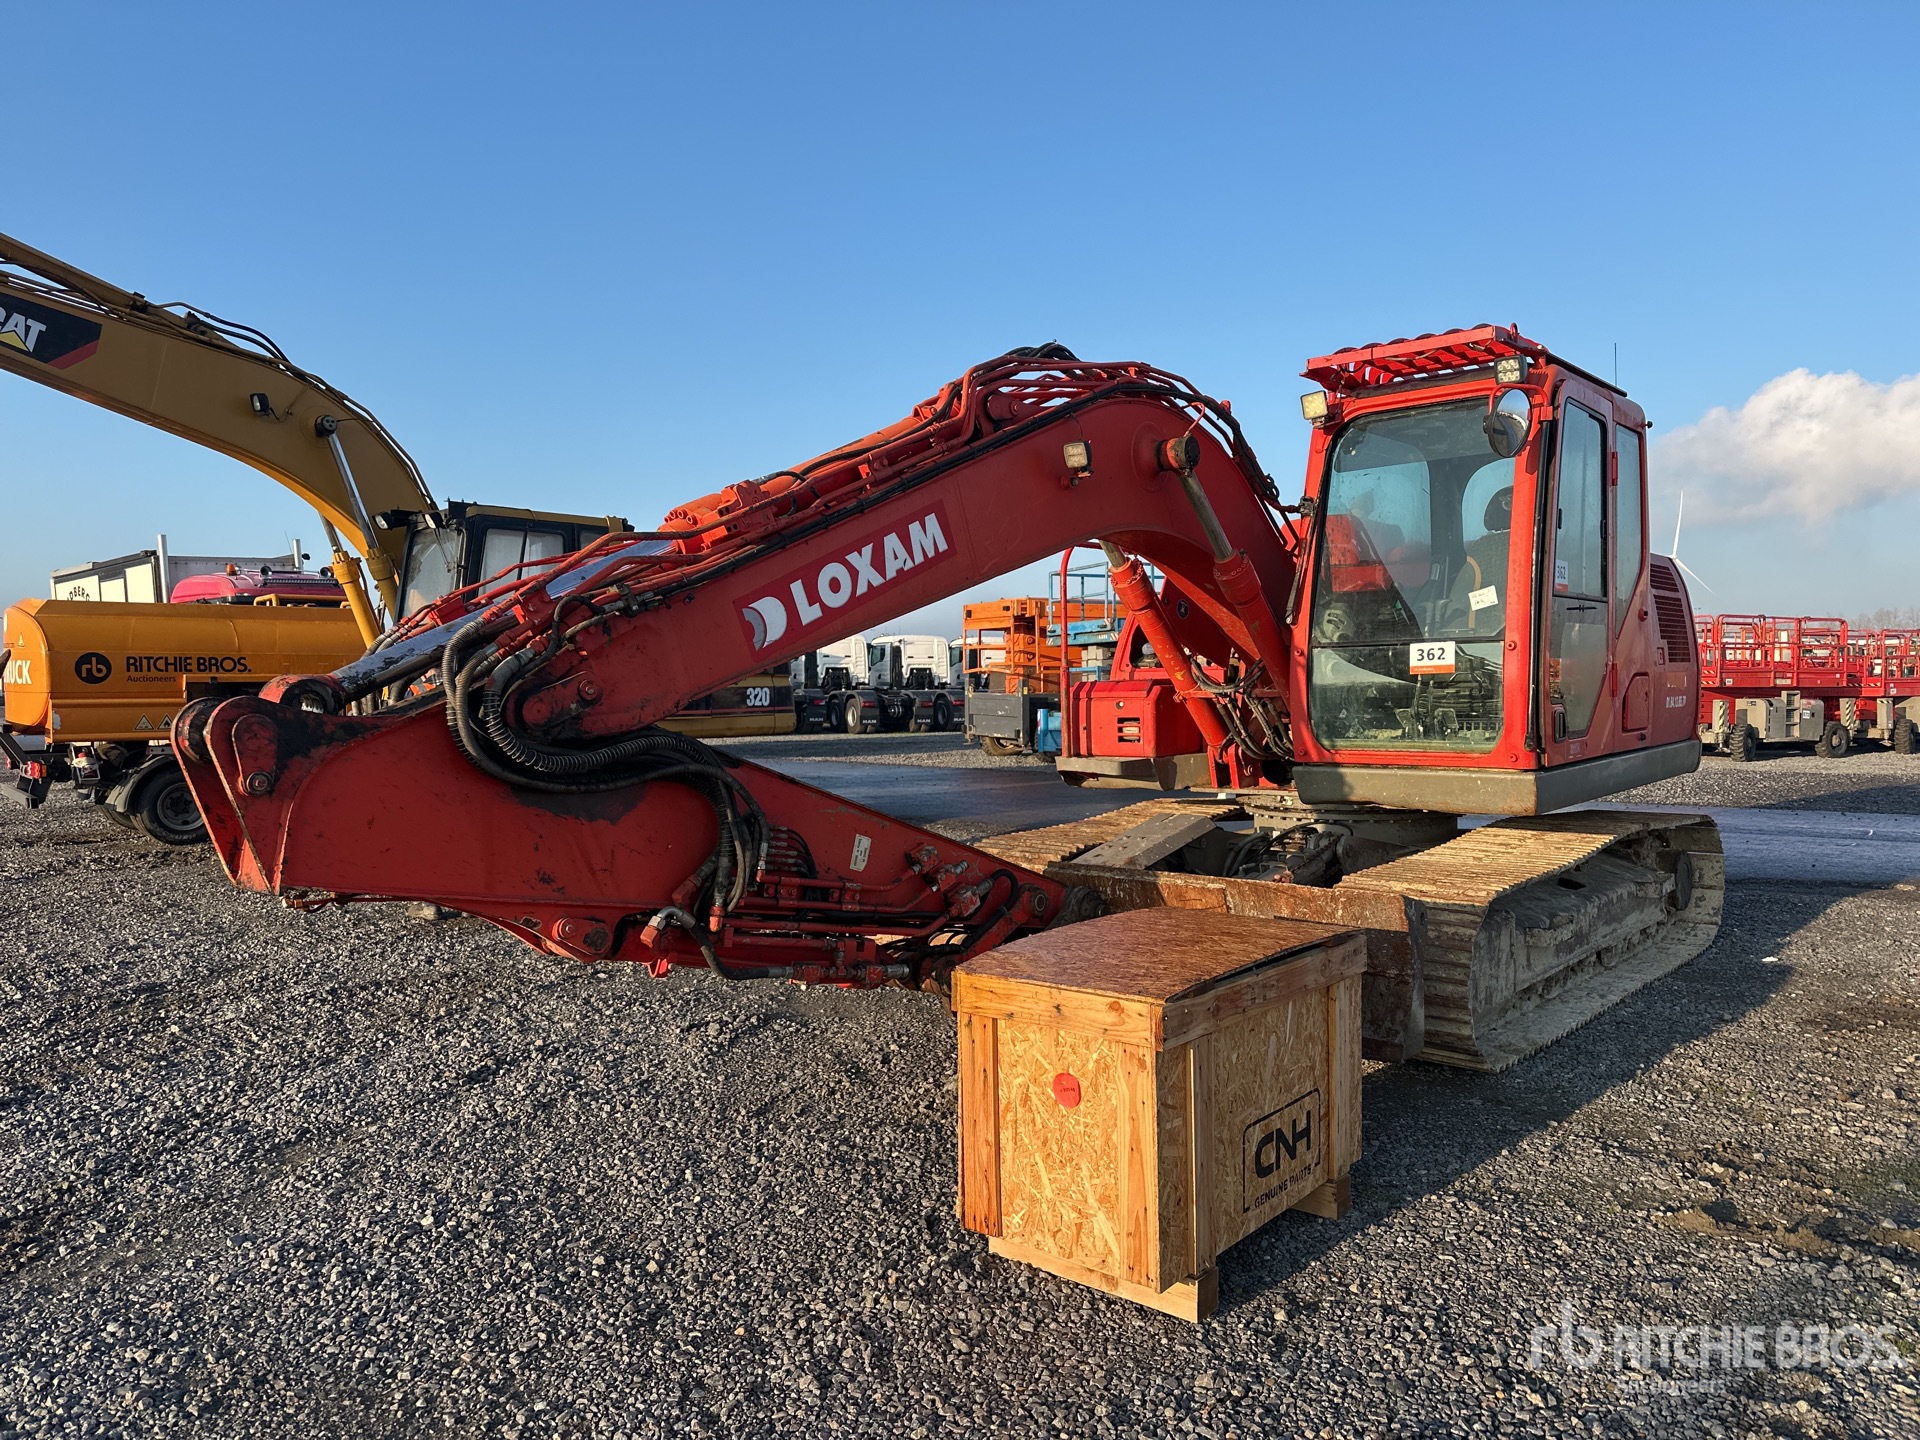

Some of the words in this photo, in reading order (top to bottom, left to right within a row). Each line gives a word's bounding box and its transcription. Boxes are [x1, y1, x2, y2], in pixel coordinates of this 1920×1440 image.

[790, 512, 949, 626] LOXAM
[1557, 565, 1566, 580] 362
[1416, 647, 1446, 661] 362
[126, 656, 193, 672] RITCHIE
[196, 656, 252, 673] BROS.
[126, 675, 176, 683] Auctioneers
[746, 687, 771, 706] 320
[1255, 1110, 1311, 1178] CNH
[1254, 1179, 1288, 1208] GENUINE
[1289, 1164, 1312, 1187] PARTS
